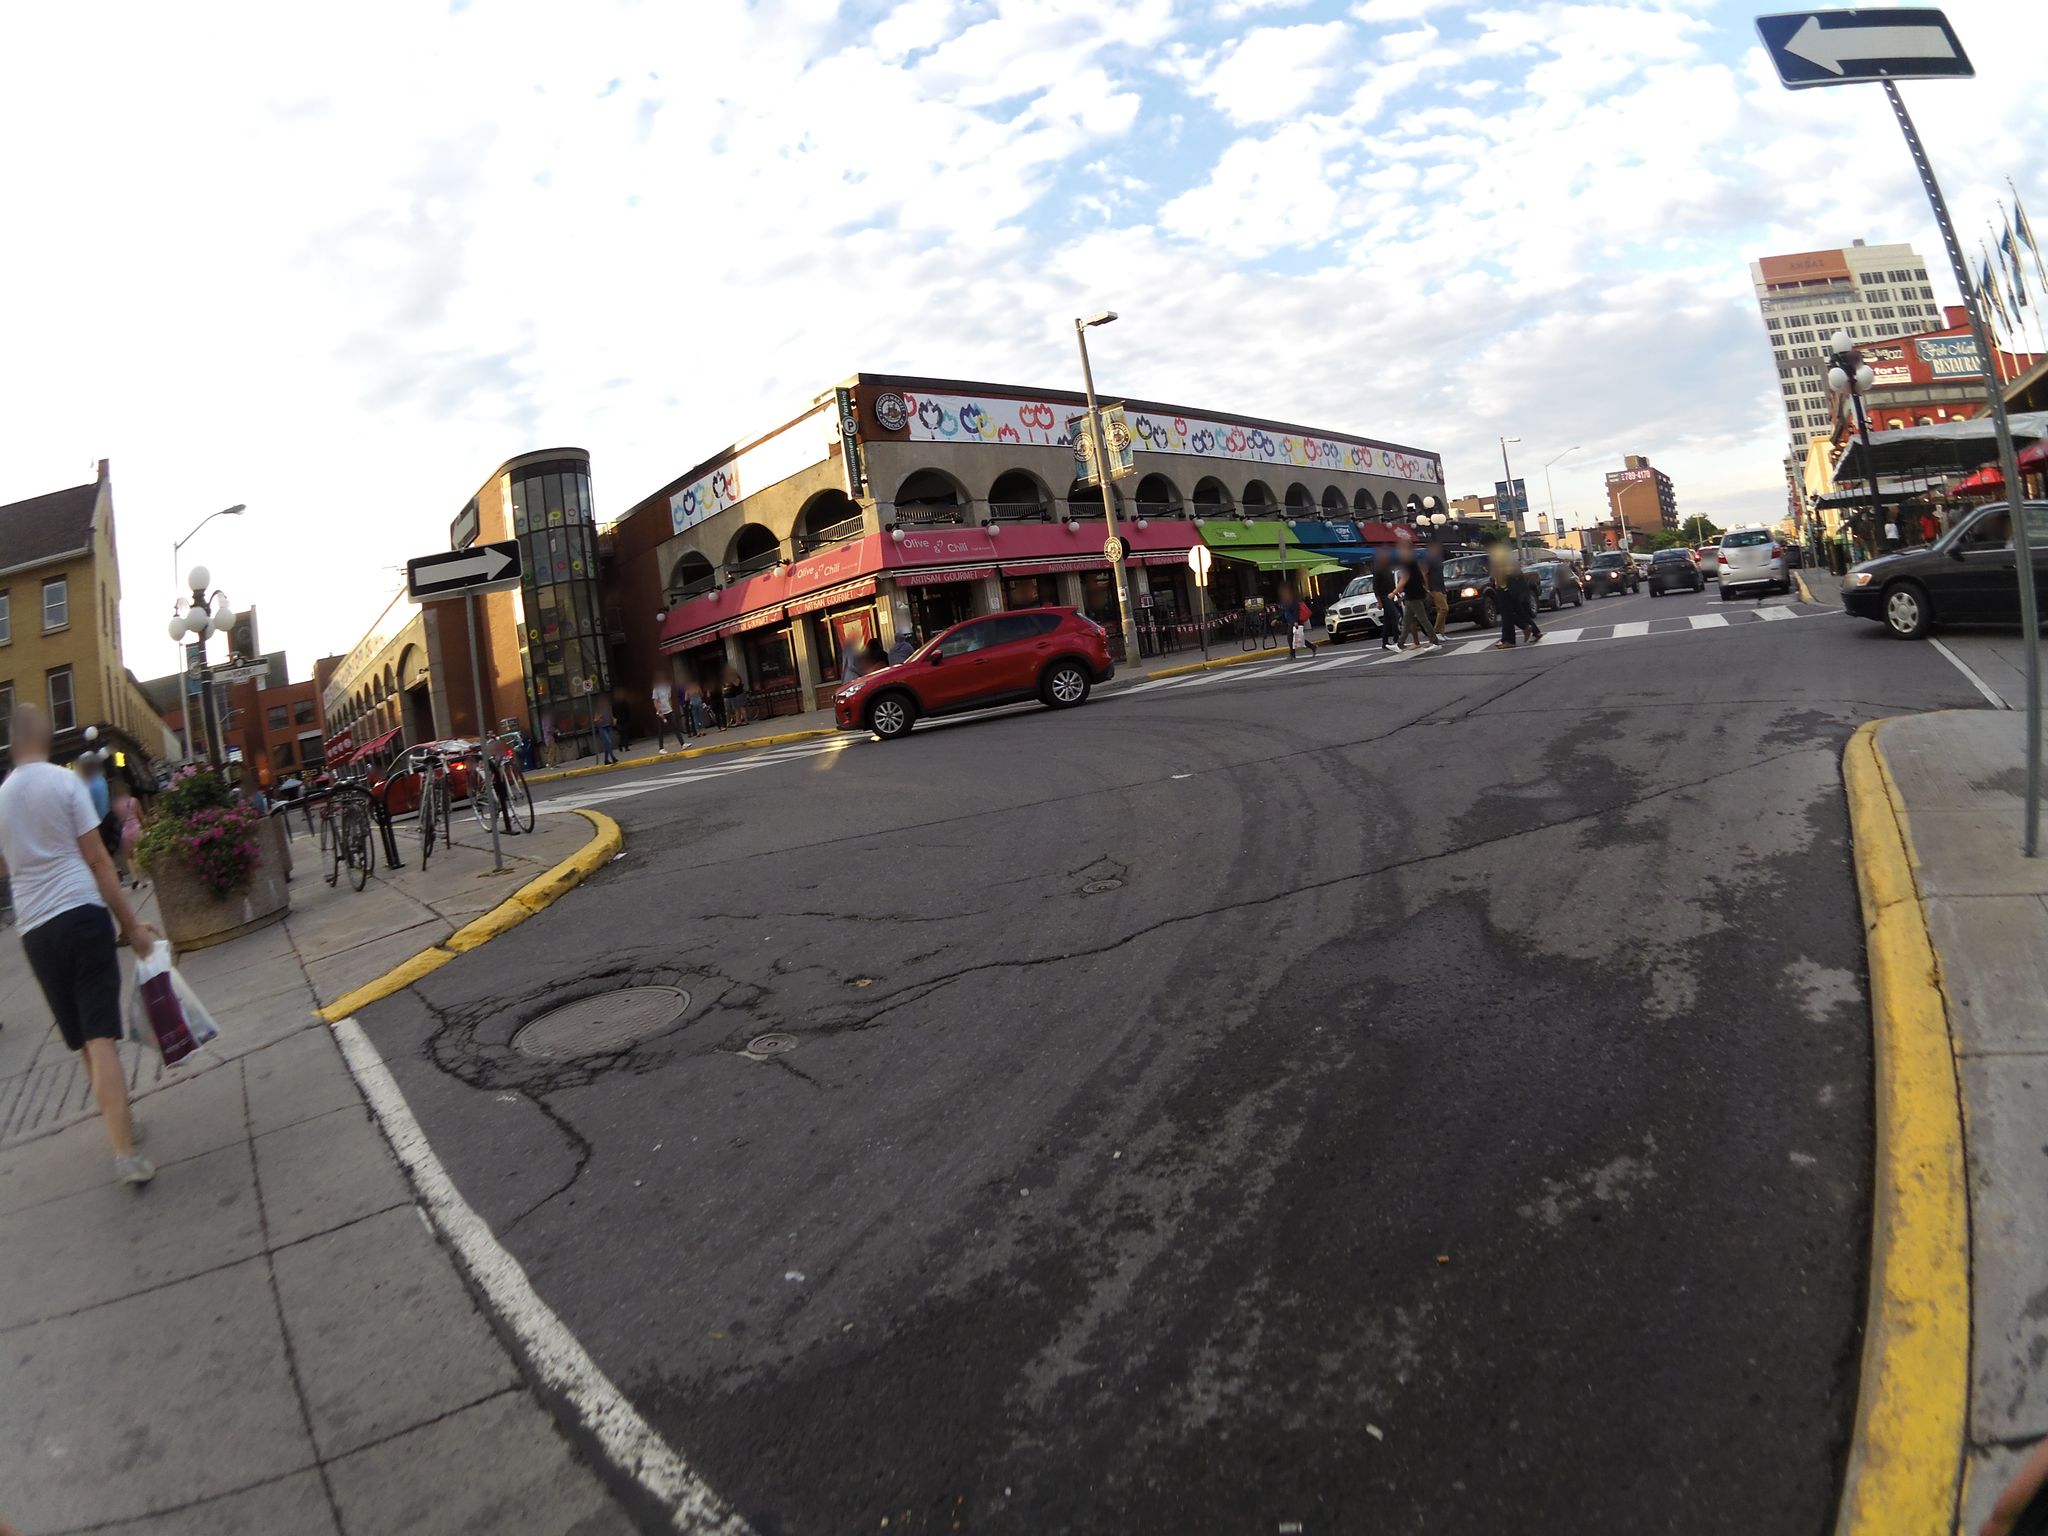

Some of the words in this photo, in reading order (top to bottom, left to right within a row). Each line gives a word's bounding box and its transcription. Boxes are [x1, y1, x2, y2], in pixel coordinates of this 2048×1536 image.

[1873, 367, 1894, 375] for
[847, 438, 859, 487] Stationnement
[903, 539, 930, 549] Olive
[947, 542, 968, 553] Chili
[797, 567, 814, 579] Olive
[823, 563, 840, 576] Chili
[910, 574, 940, 585] ARTISAN
[943, 571, 979, 581] GOURMET
[804, 598, 825, 611] ARTISAN
[827, 591, 854, 606] GOURMET
